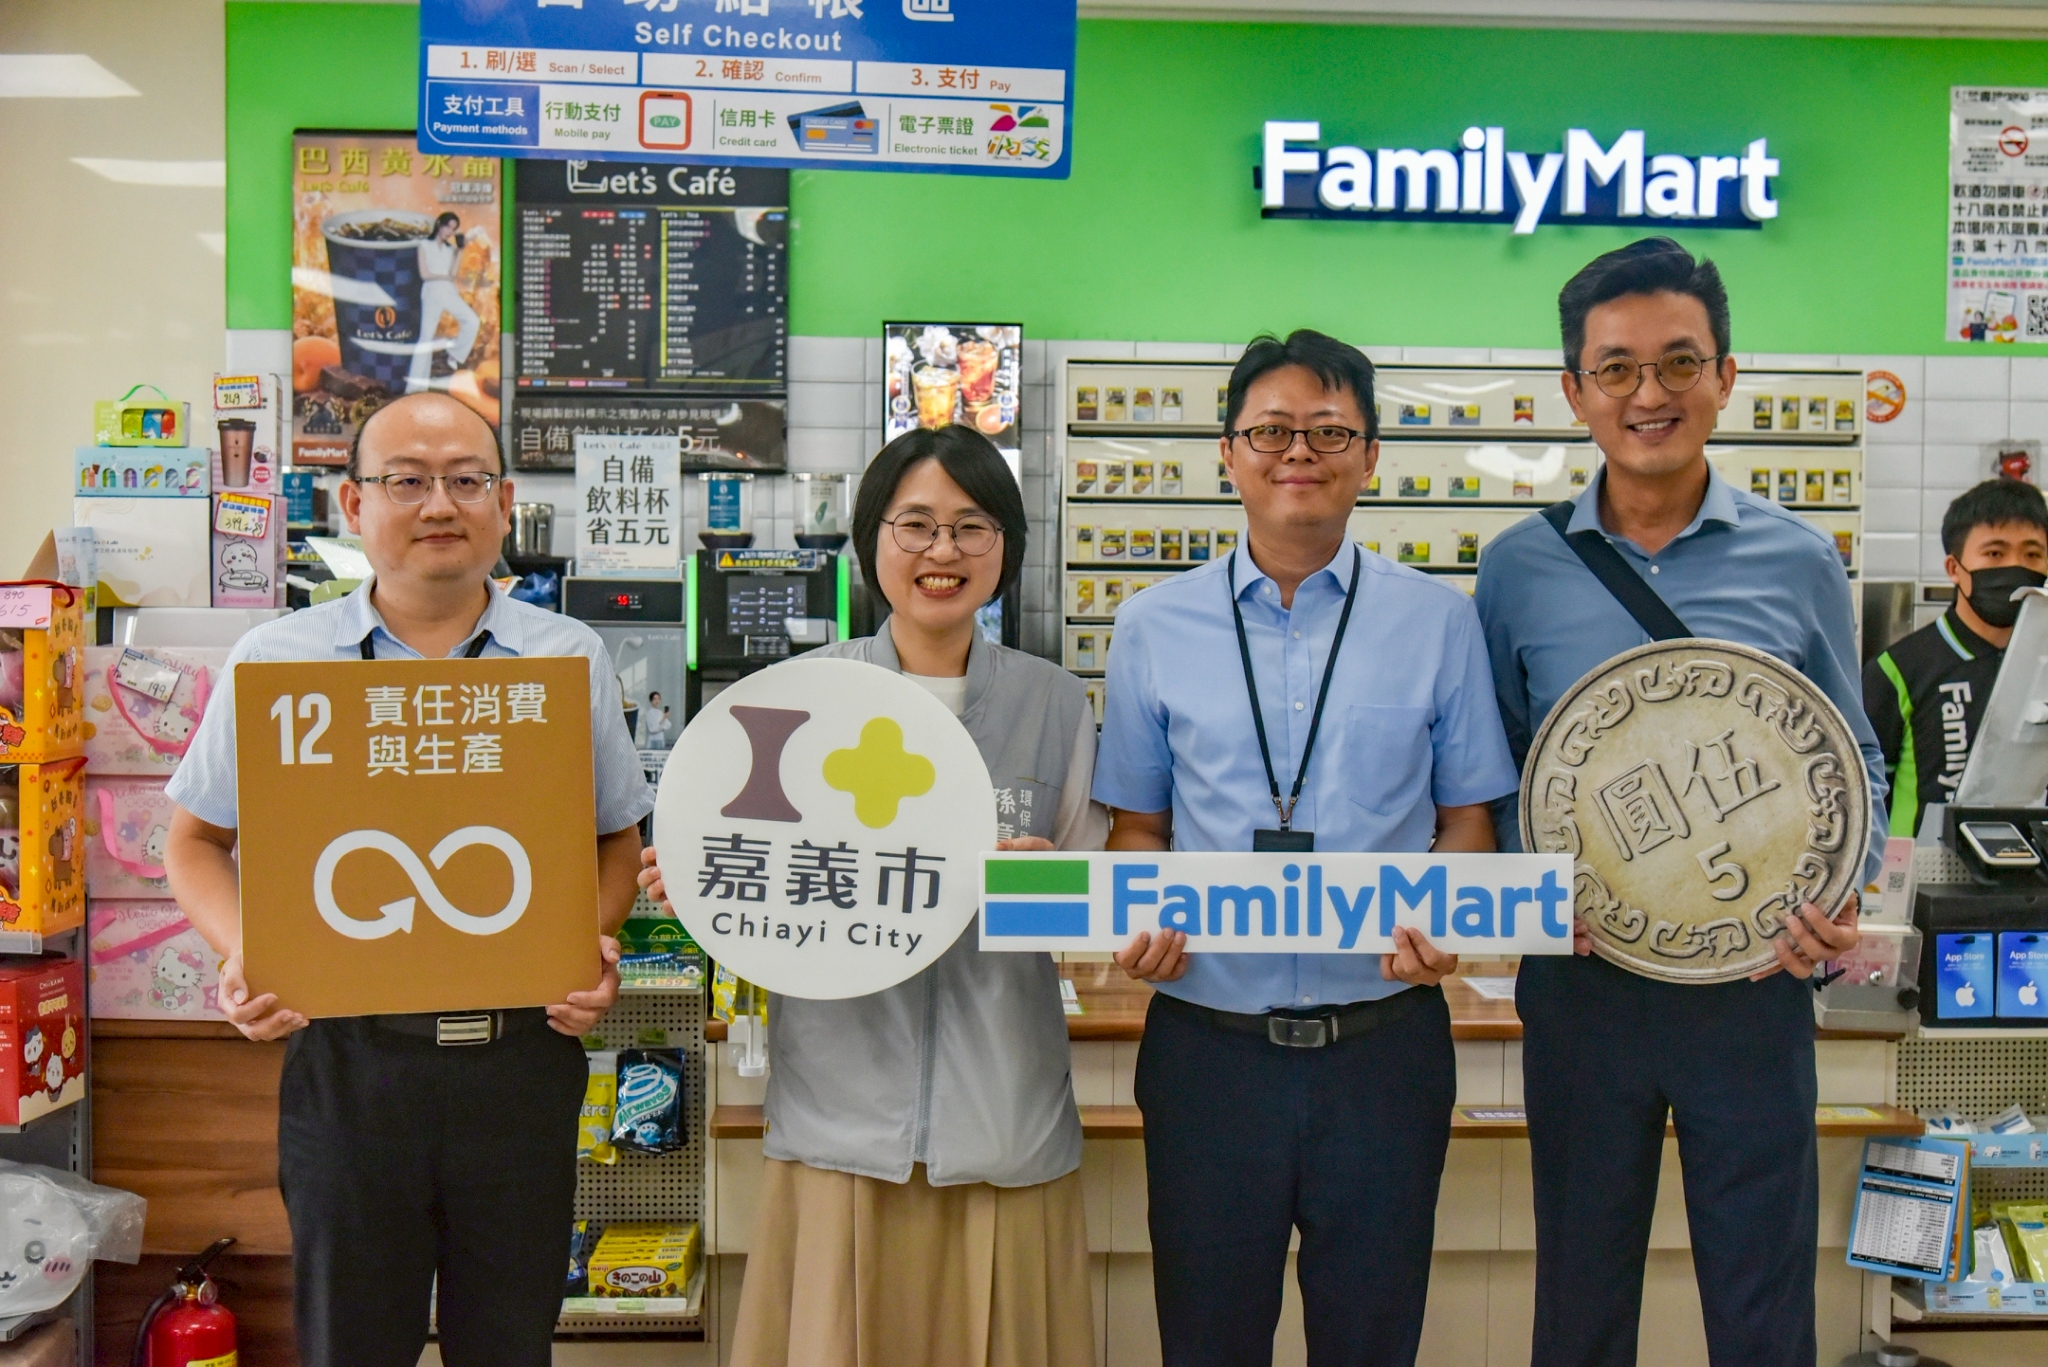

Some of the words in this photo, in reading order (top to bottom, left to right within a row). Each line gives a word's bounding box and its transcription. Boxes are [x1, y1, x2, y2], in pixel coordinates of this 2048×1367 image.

[635, 22, 692, 46] Self
[703, 24, 842, 51] Checkout
[460, 51, 478, 70] 1.
[485, 51, 537, 72] 刷/選
[549, 63, 578, 74] Scan
[588, 64, 625, 75] Select
[695, 60, 714, 79] 2.
[721, 60, 765, 81] 確認
[775, 71, 822, 84] Confirm
[911, 68, 930, 87] 3.
[937, 68, 980, 90] 支付
[989, 79, 1012, 93] Pay
[442, 95, 525, 117] 支付工具
[545, 101, 621, 123] 行動支付
[433, 121, 479, 136] Payment
[481, 123, 528, 136] methods
[653, 117, 677, 127] PAY
[719, 108, 776, 129] 信用卡
[899, 115, 974, 136] 電子票證
[554, 128, 589, 140] Mobile
[591, 130, 611, 141] pay
[719, 136, 751, 147] Credit
[753, 137, 777, 148] card
[894, 143, 947, 155] Electronic
[949, 145, 978, 156] ticket
[567, 160, 657, 194] Let's
[668, 167, 736, 196] Café
[1262, 121, 1780, 234] FamilyMart
[298, 446, 349, 459] FamilyMart
[603, 454, 655, 484] 自備
[586, 485, 670, 515] 飲料杯
[586, 517, 670, 546] 省五元
[3, 590, 25, 600] 890
[147, 681, 167, 699] 199
[364, 682, 548, 728] 責任消費
[270, 692, 333, 766] 12
[1937, 681, 1972, 801] Family
[367, 732, 504, 777] 與生產
[698, 833, 947, 914] 嘉義市
[1697, 841, 1749, 901] 5
[1112, 862, 1569, 950] FamilyMart
[711, 911, 827, 948] Chiayi
[847, 922, 923, 957] City
[1944, 952, 1962, 963] App
[1963, 952, 1985, 961] Store
[2009, 950, 2027, 961] App
[617, 1083, 672, 1126] Airwaves
[590, 1265, 609, 1273] meiji
[612, 1270, 662, 1286] きのこの山
